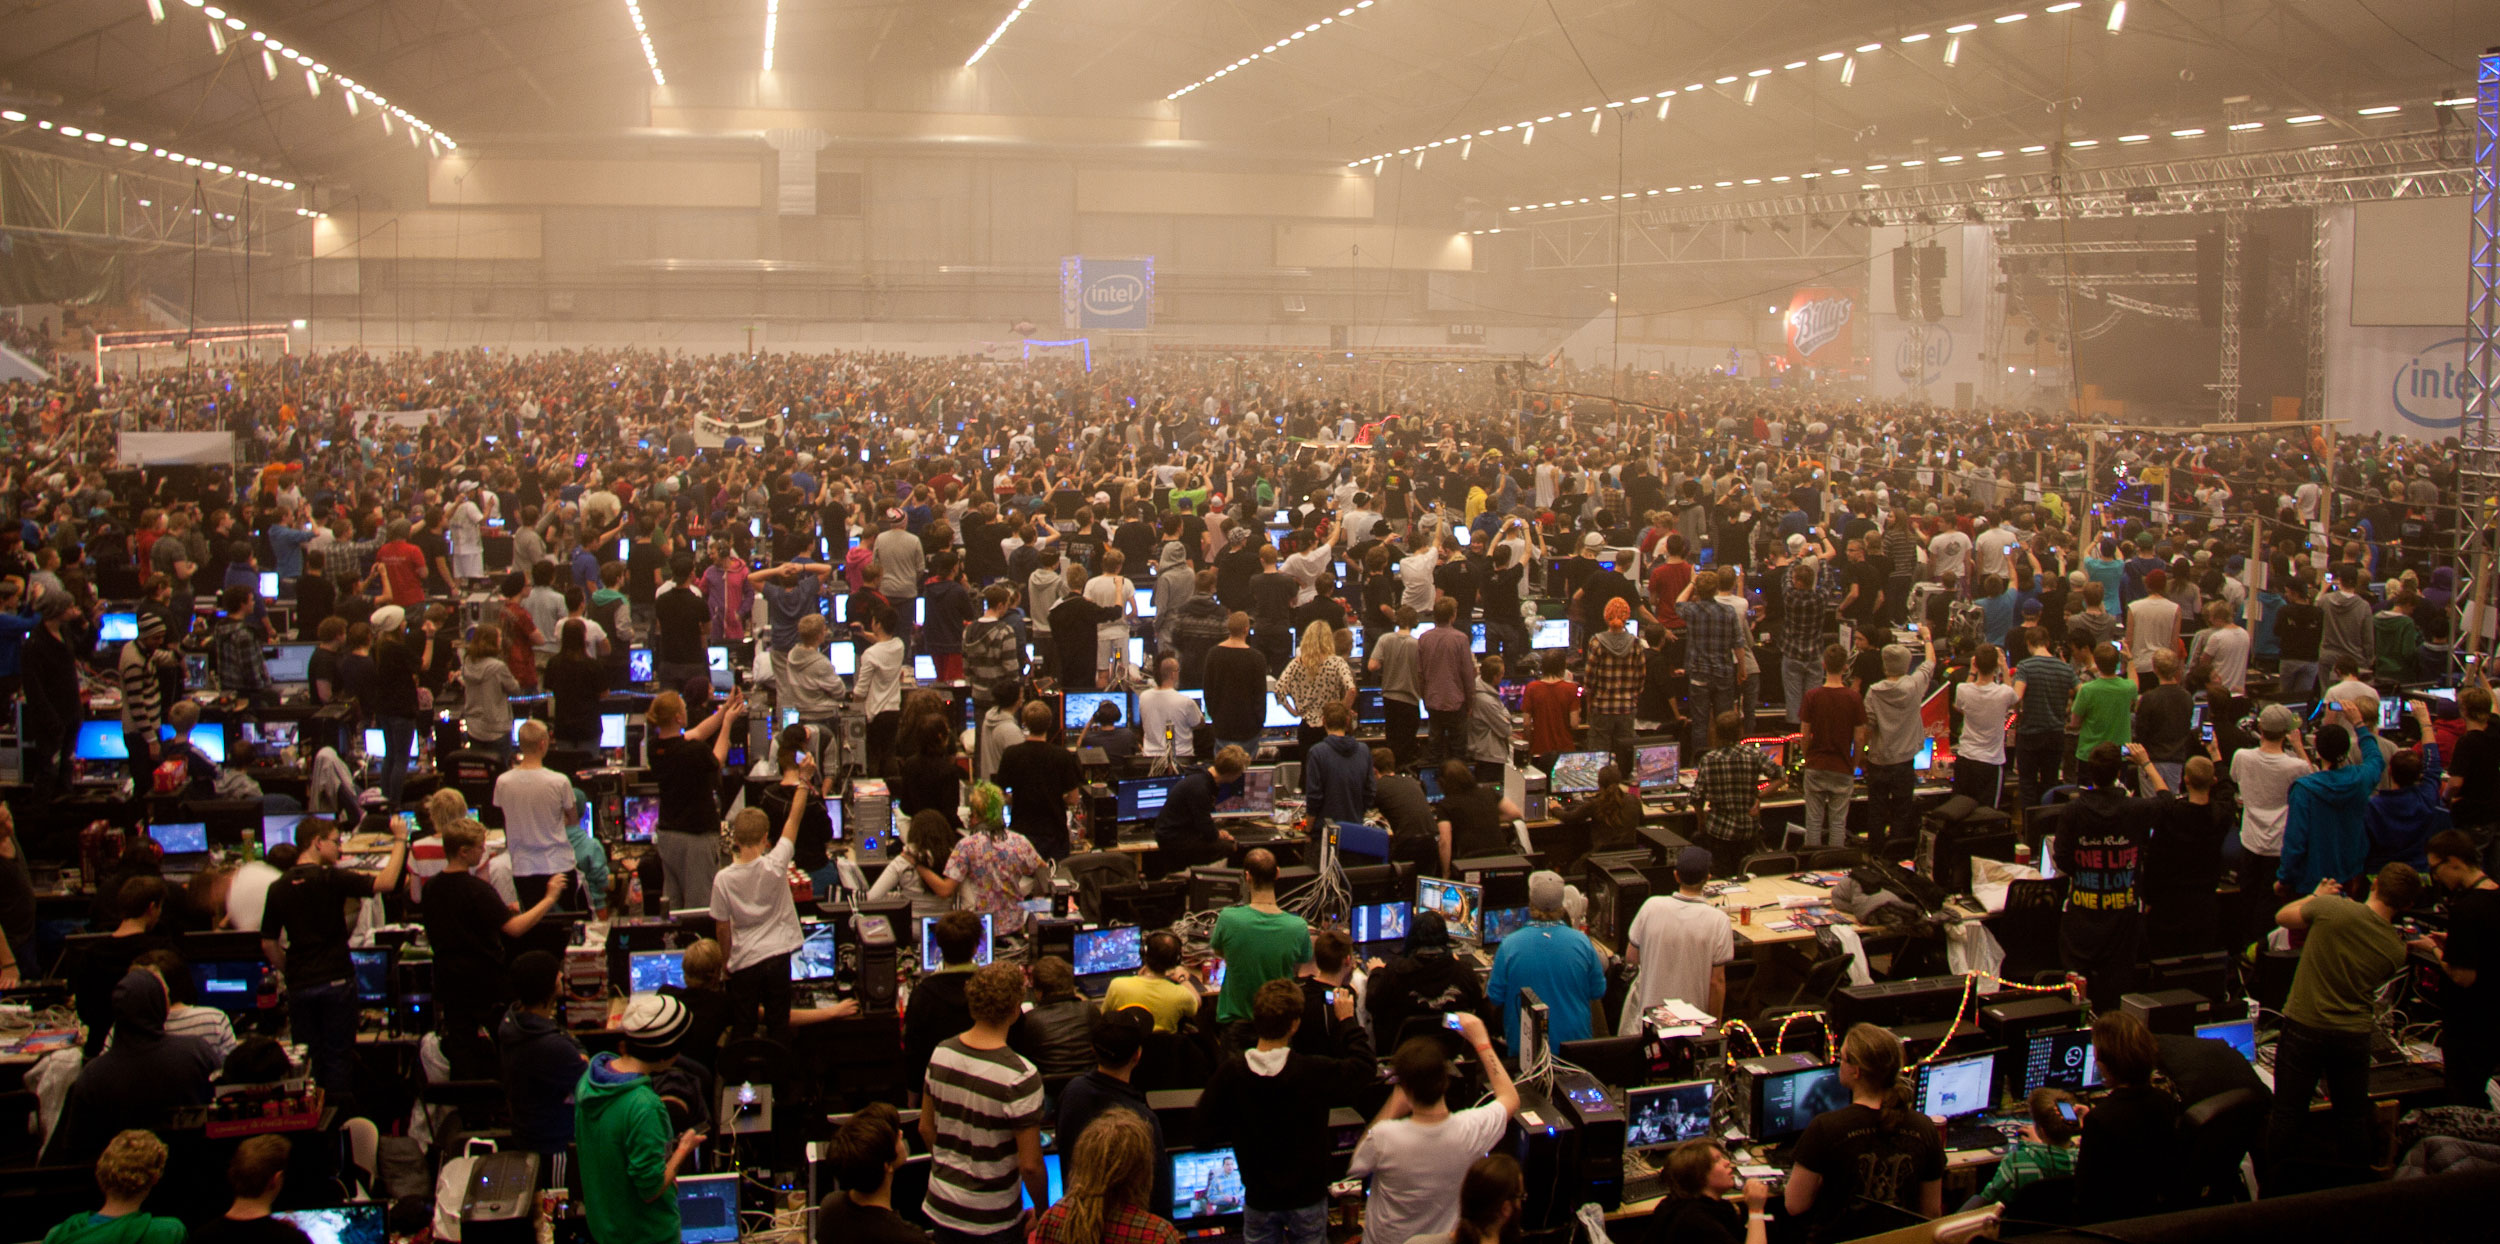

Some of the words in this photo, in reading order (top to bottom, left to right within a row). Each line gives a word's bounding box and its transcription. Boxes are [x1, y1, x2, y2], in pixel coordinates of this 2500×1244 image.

[1092, 283, 1134, 302] intel
[2411, 358, 2484, 399] inte
[2103, 870, 2134, 890] LOV
[2072, 890, 2098, 910] ONE
